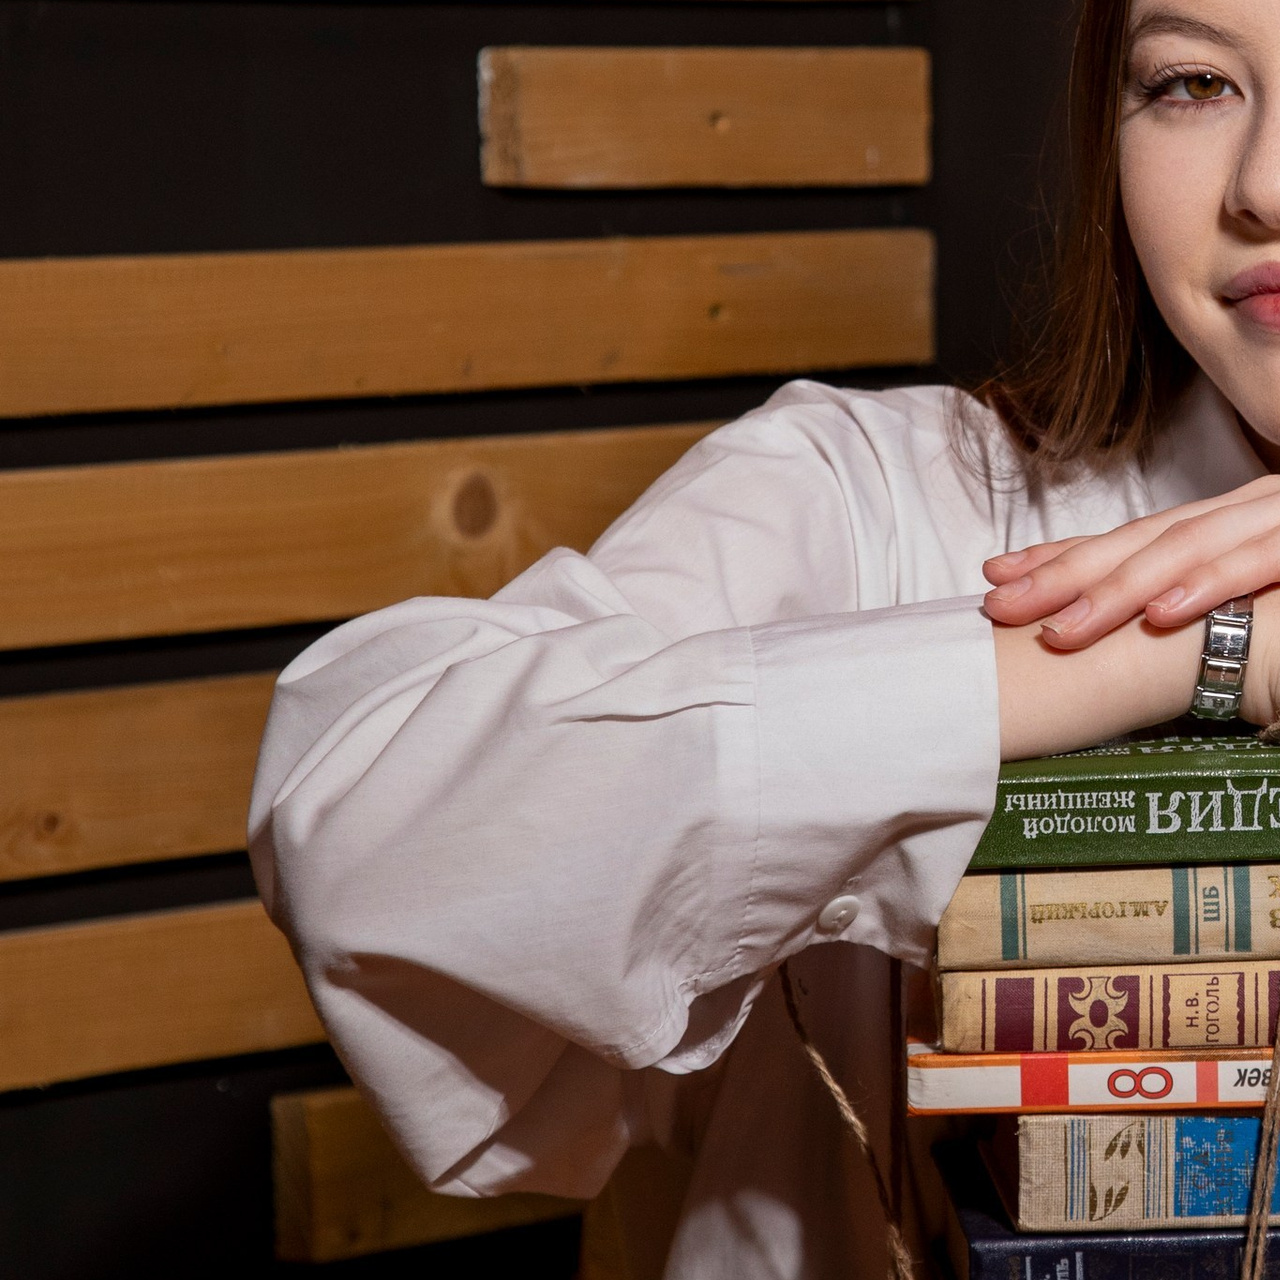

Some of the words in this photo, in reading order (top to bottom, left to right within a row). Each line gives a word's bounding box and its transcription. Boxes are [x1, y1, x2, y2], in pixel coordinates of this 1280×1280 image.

[1003, 789, 1136, 812] ЖЕНЩИНЫ
[1022, 812, 1136, 839] МОЛОДОЙ
[1185, 991, 1200, 1029] Н.В.
[1205, 976, 1220, 1043] ГОГОЛЬ
[1107, 1066, 1173, 1100] 8
[1232, 1068, 1272, 1088] век
